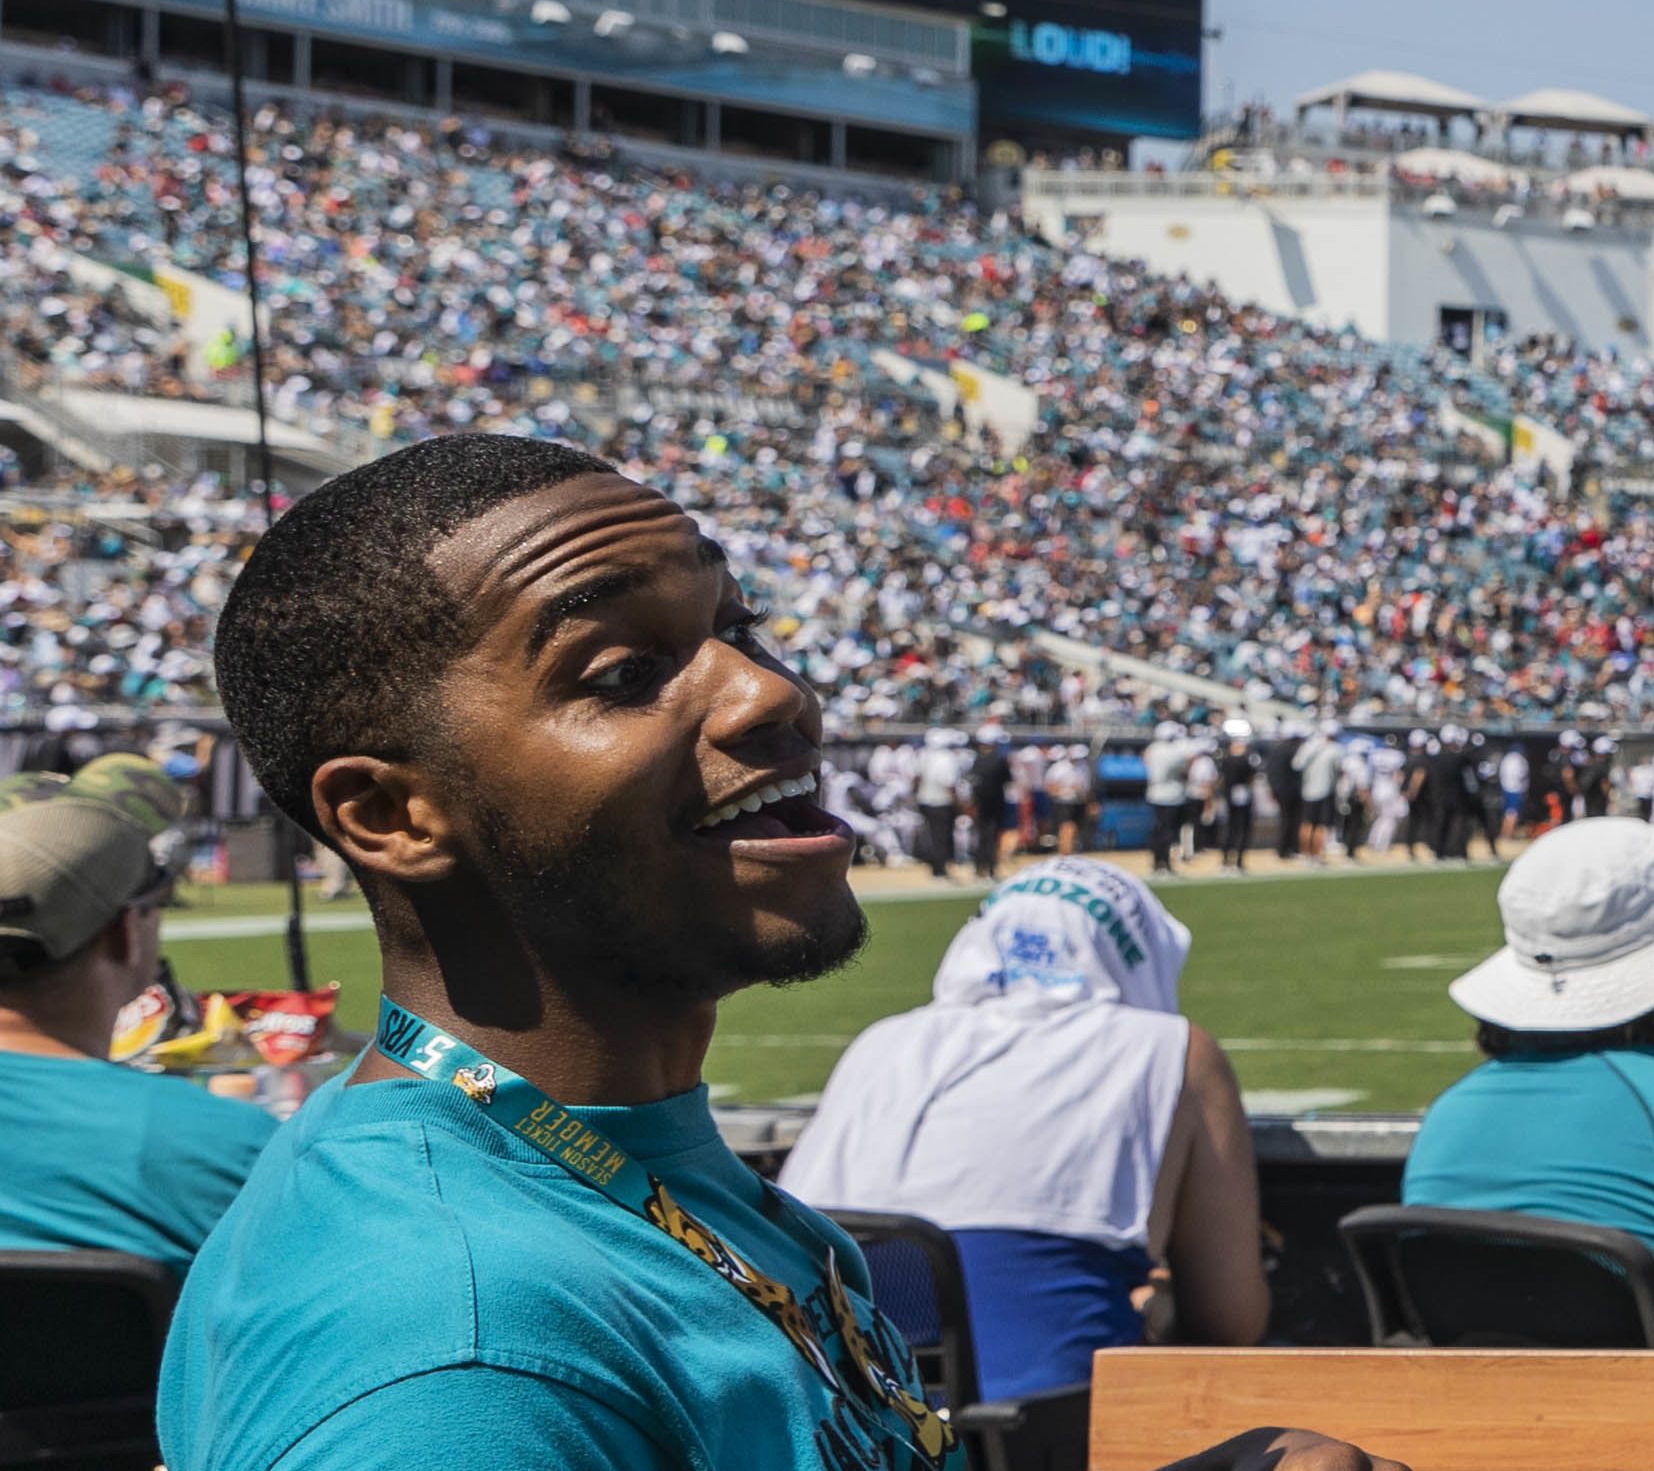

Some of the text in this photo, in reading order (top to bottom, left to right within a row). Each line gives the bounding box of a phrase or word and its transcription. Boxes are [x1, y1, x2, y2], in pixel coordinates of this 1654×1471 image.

[1010, 17, 1132, 76] LOUD!
[379, 1008, 426, 1060] YRS
[514, 1115, 615, 1187] SEASON TICKET
[529, 1099, 627, 1174] MEMBER
